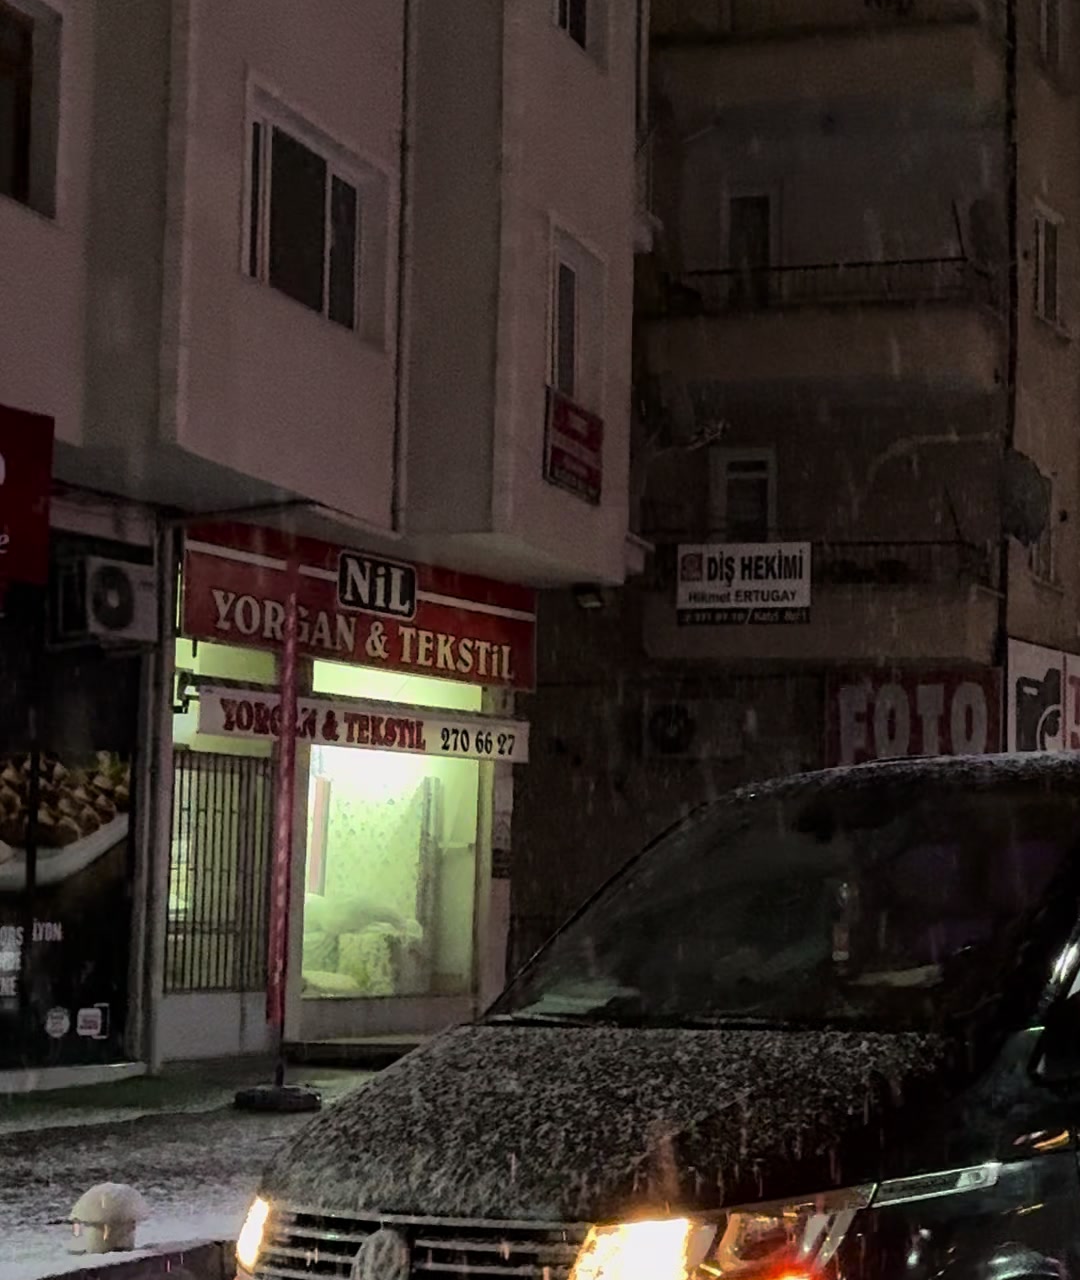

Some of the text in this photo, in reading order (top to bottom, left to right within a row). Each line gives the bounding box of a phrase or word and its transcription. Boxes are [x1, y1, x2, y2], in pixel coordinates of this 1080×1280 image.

[707, 549, 803, 586] DİŞ HEKİMİ
[365, 621, 390, 659] &
[322, 709, 340, 741] &
[441, 727, 470, 752] 270
[475, 730, 493, 754] 66
[498, 733, 516, 755] 27
[837, 680, 989, 763] FOTO
